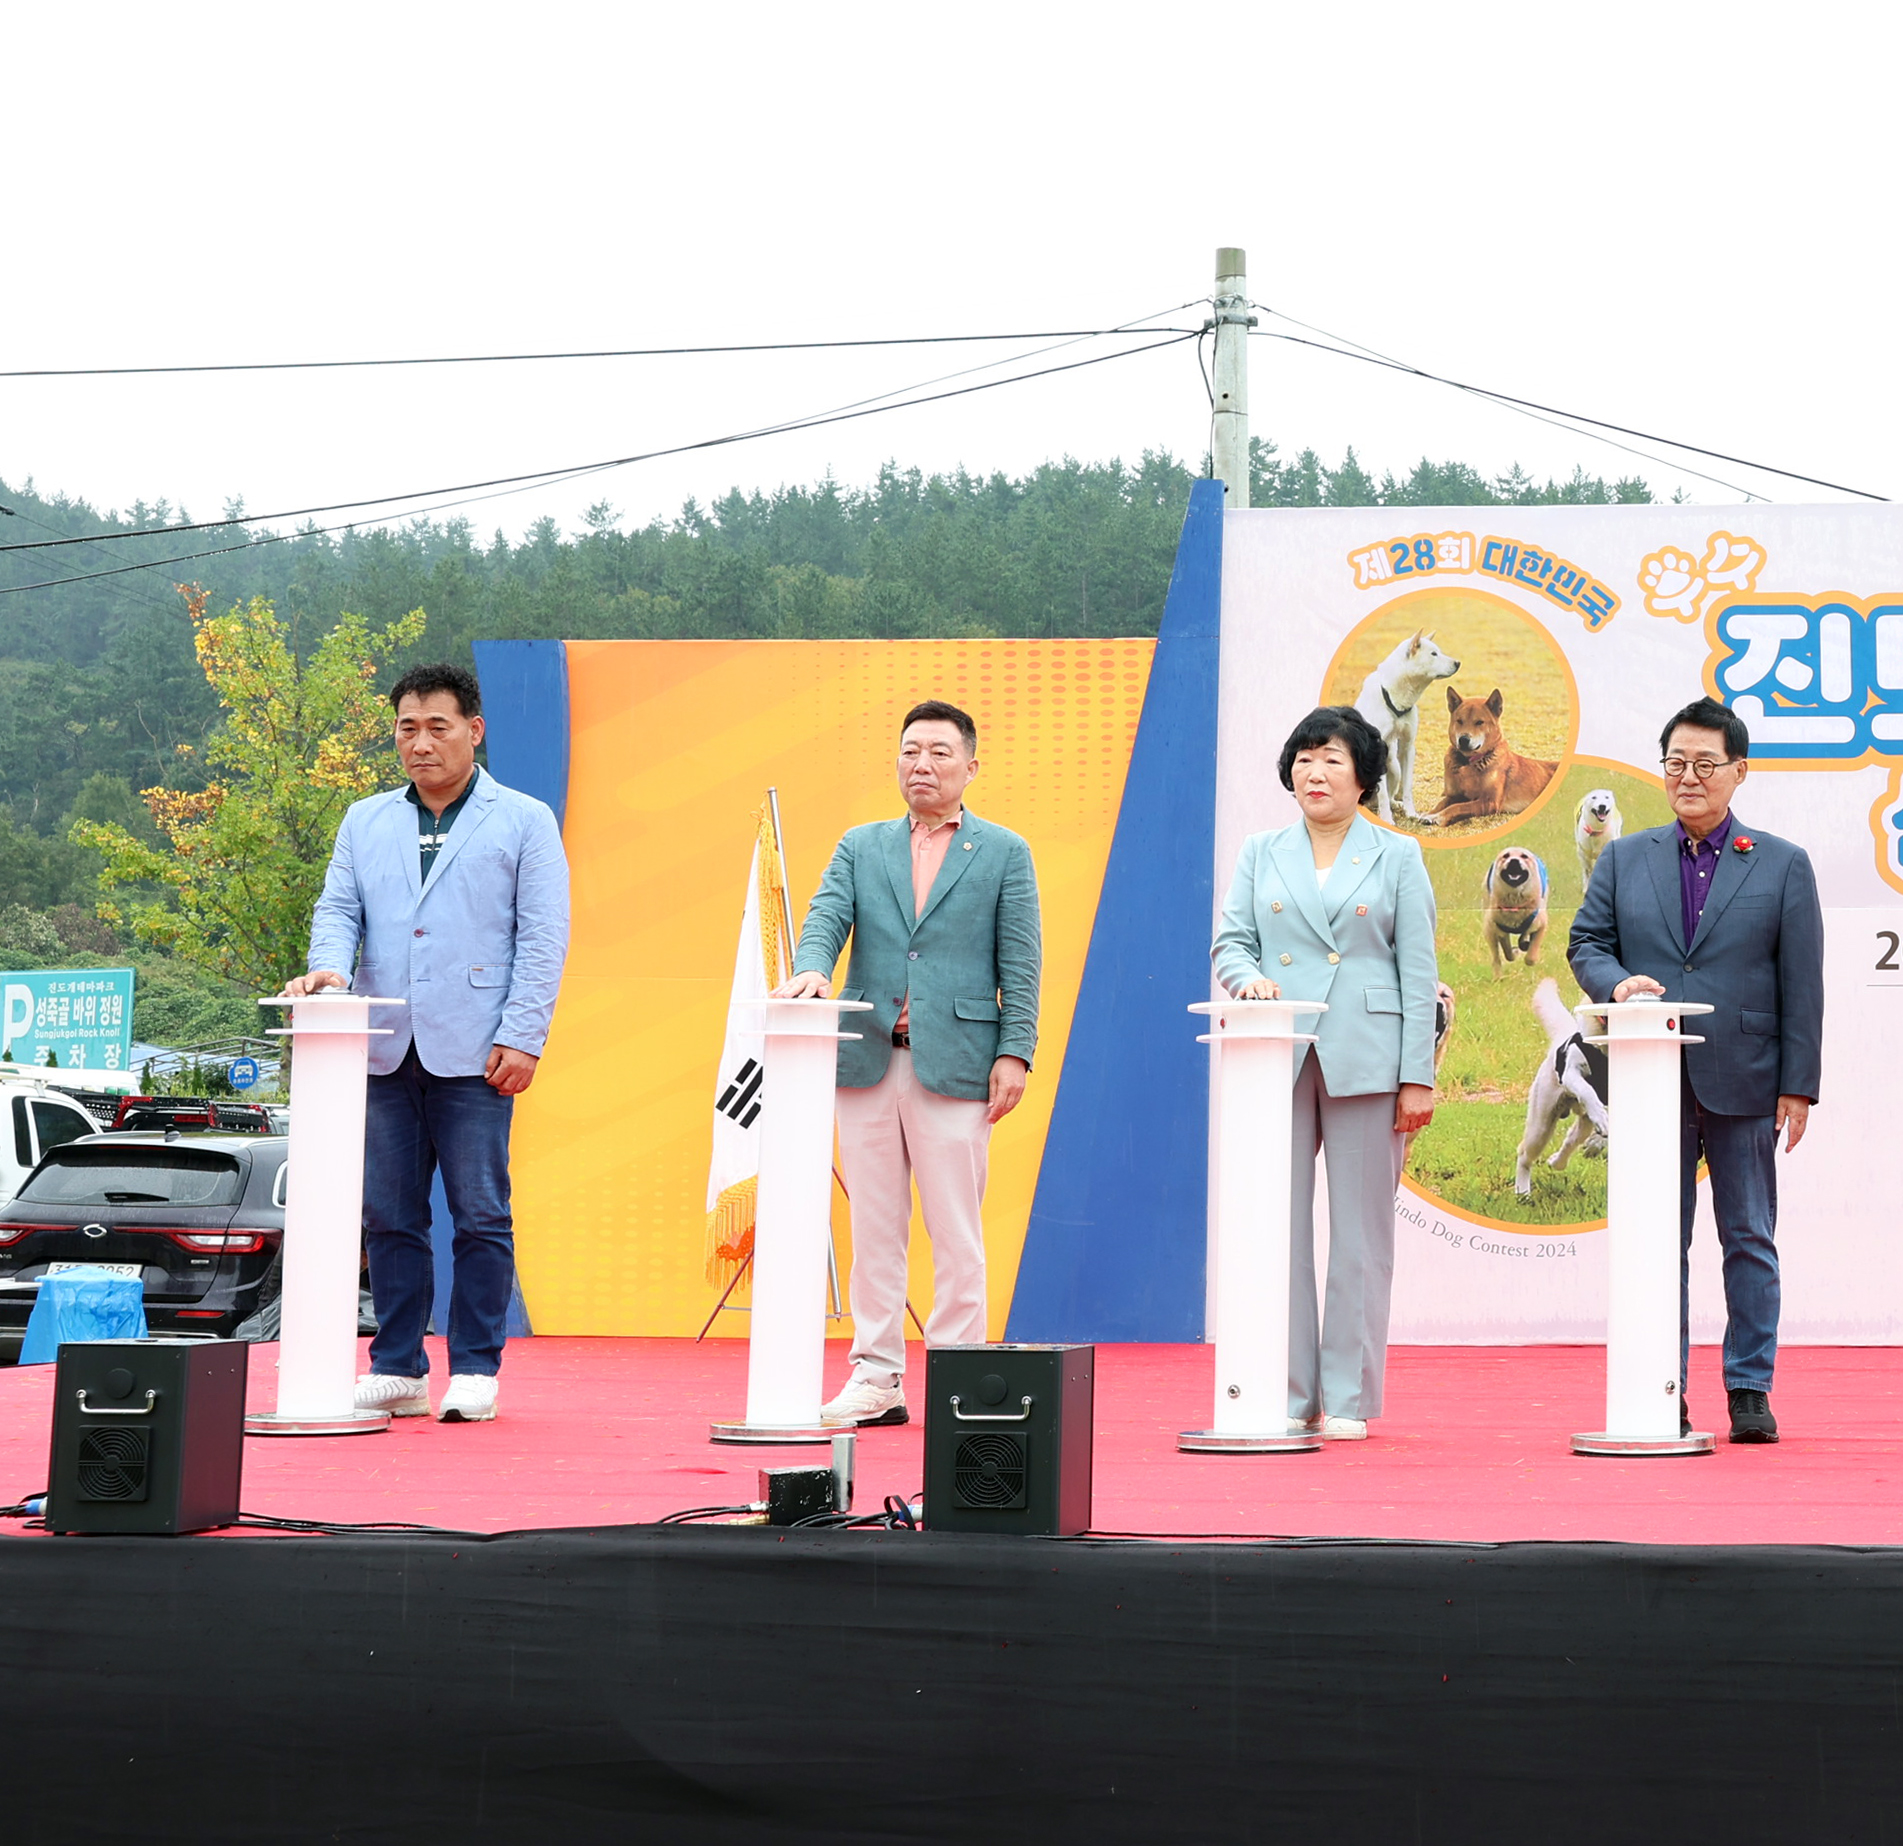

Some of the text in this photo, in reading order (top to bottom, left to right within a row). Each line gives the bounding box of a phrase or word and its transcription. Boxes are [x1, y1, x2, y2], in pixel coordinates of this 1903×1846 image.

[1353, 536, 1615, 627] 제28회 대한민국
[3, 983, 35, 1056] P
[36, 994, 123, 1027] 성죽골 바위 정원
[79, 1028, 98, 1038] Rock
[99, 1027, 120, 1038] Knoll
[1431, 1220, 1464, 1248] Dog
[1469, 1235, 1529, 1258] Contest
[1536, 1241, 1577, 1258] 2024
